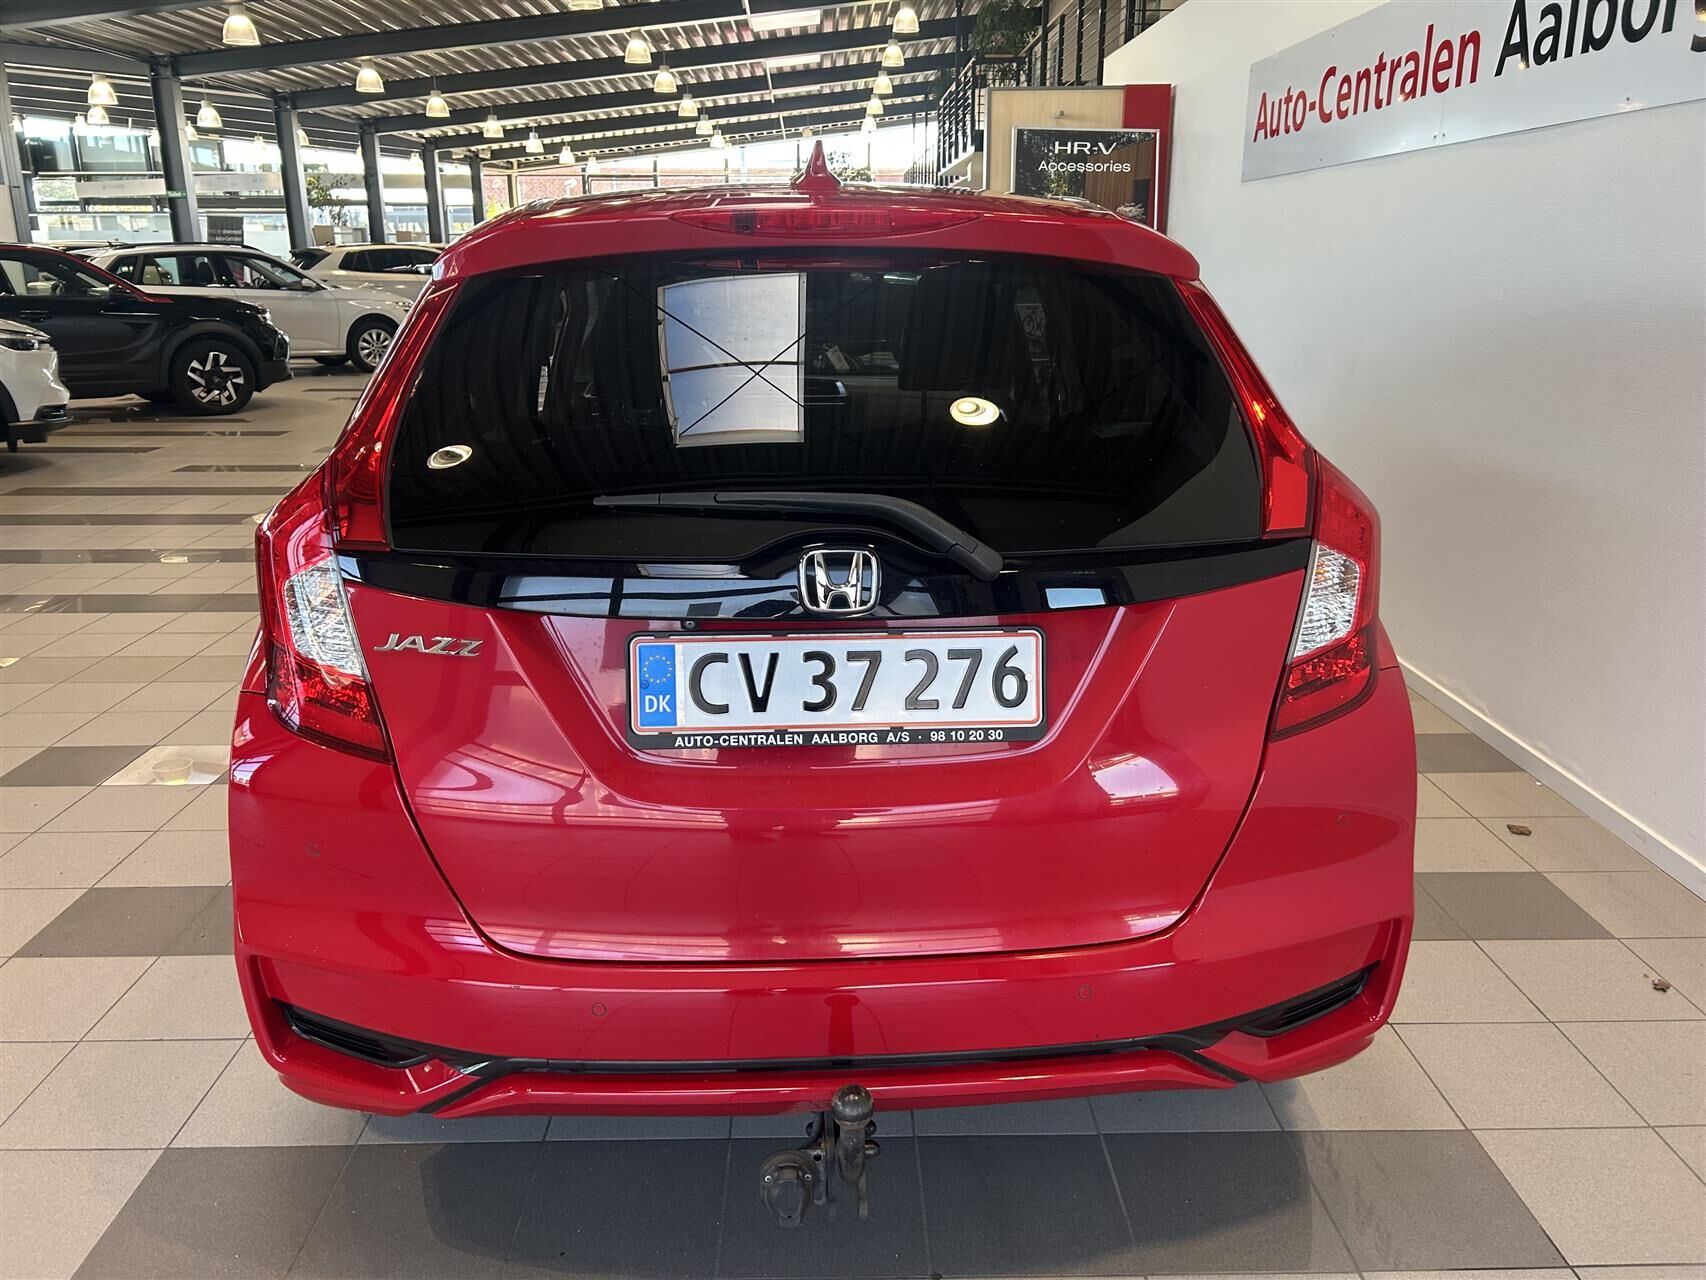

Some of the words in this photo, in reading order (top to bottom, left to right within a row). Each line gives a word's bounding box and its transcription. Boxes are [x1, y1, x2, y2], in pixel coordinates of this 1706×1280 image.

[1253, 23, 1481, 143] Auto-Centralen
[1494, 0, 1706, 77] Aalbo
[1054, 141, 1117, 155] HR-V
[1038, 160, 1131, 173] Accessories
[373, 633, 484, 657] JAZZ
[688, 652, 780, 714] CV
[802, 648, 882, 712] 37
[903, 645, 1029, 710] 276
[644, 693, 672, 713] DK
[674, 734, 803, 748] AUTO-CENTRALEN
[811, 732, 878, 745] AALBORG
[886, 731, 910, 743] A/S
[930, 731, 946, 741] 98
[950, 730, 965, 741] 10
[968, 729, 984, 740] 20
[988, 729, 1004, 740] 30
